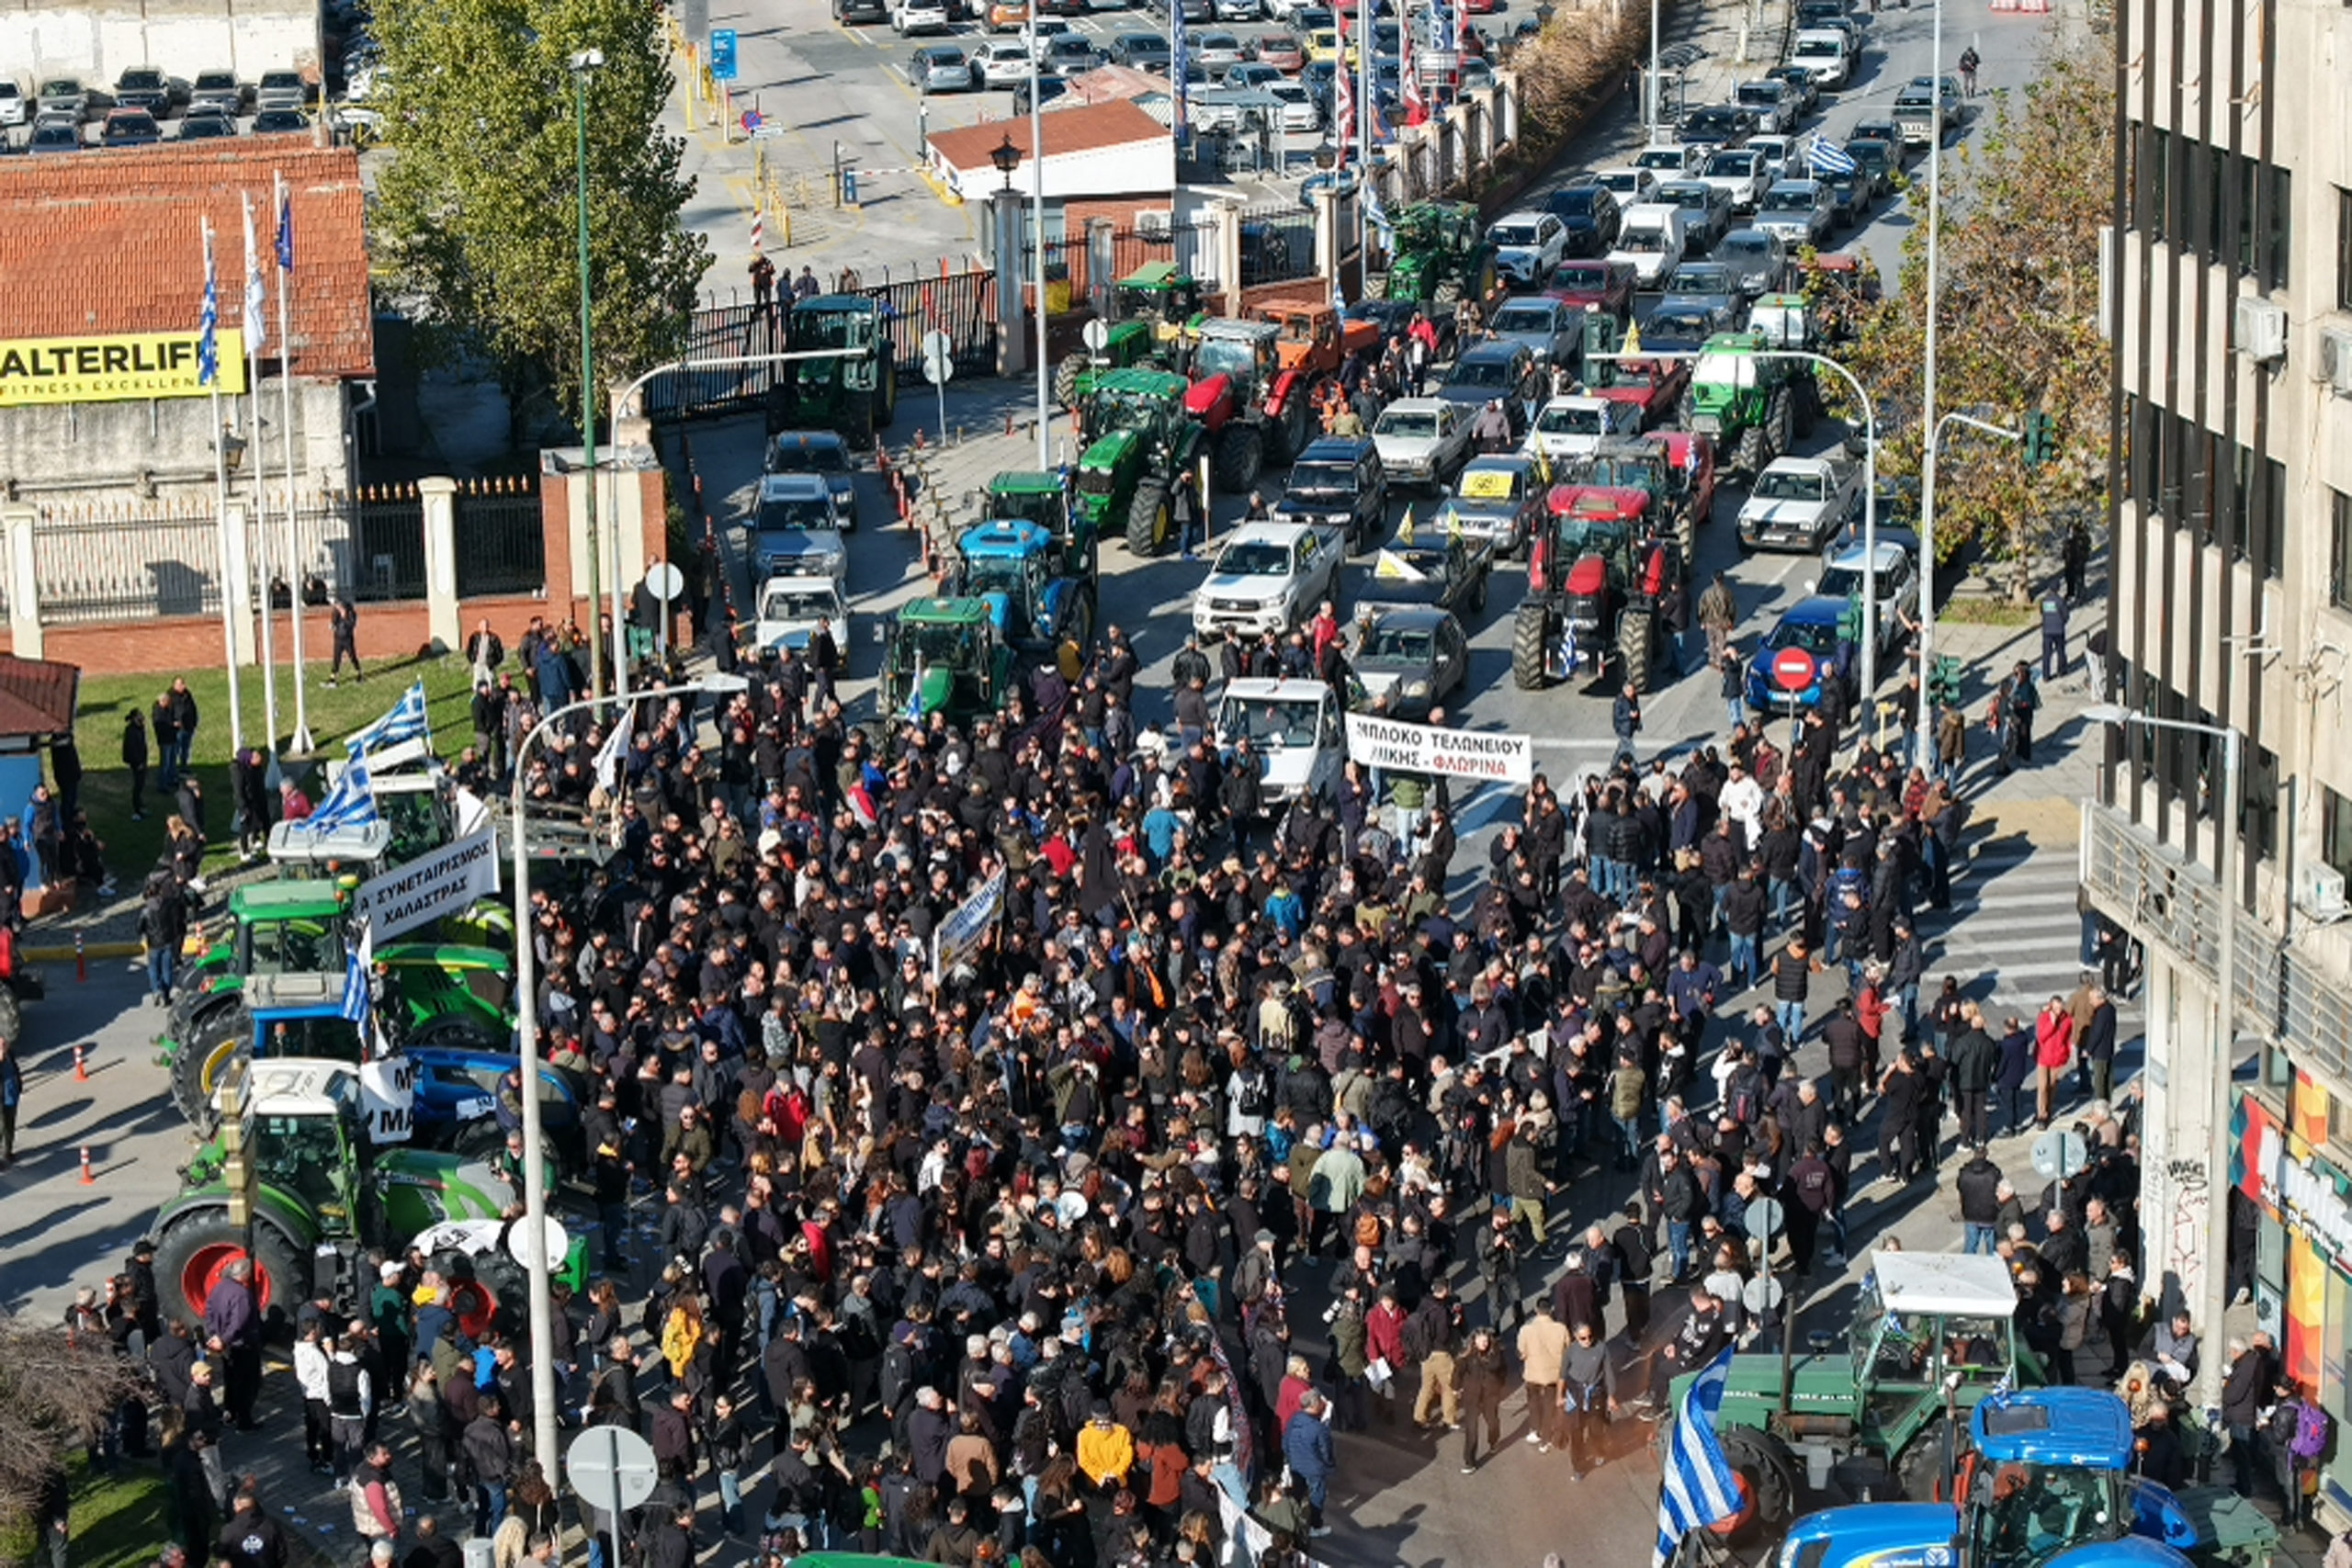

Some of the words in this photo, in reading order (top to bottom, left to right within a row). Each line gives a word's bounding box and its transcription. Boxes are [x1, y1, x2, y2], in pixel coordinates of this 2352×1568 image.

[1430, 733, 1523, 756] ΤΕΛΩΝΕΙΟΥ
[1433, 753, 1508, 776] ΦΛΩΡΙΝΑ
[377, 839, 490, 905] ΣΥΝΕΤΑΙΡΙΣΜΟΣ
[383, 874, 468, 928] ΧΑΛΑΣΤΡΑΣ
